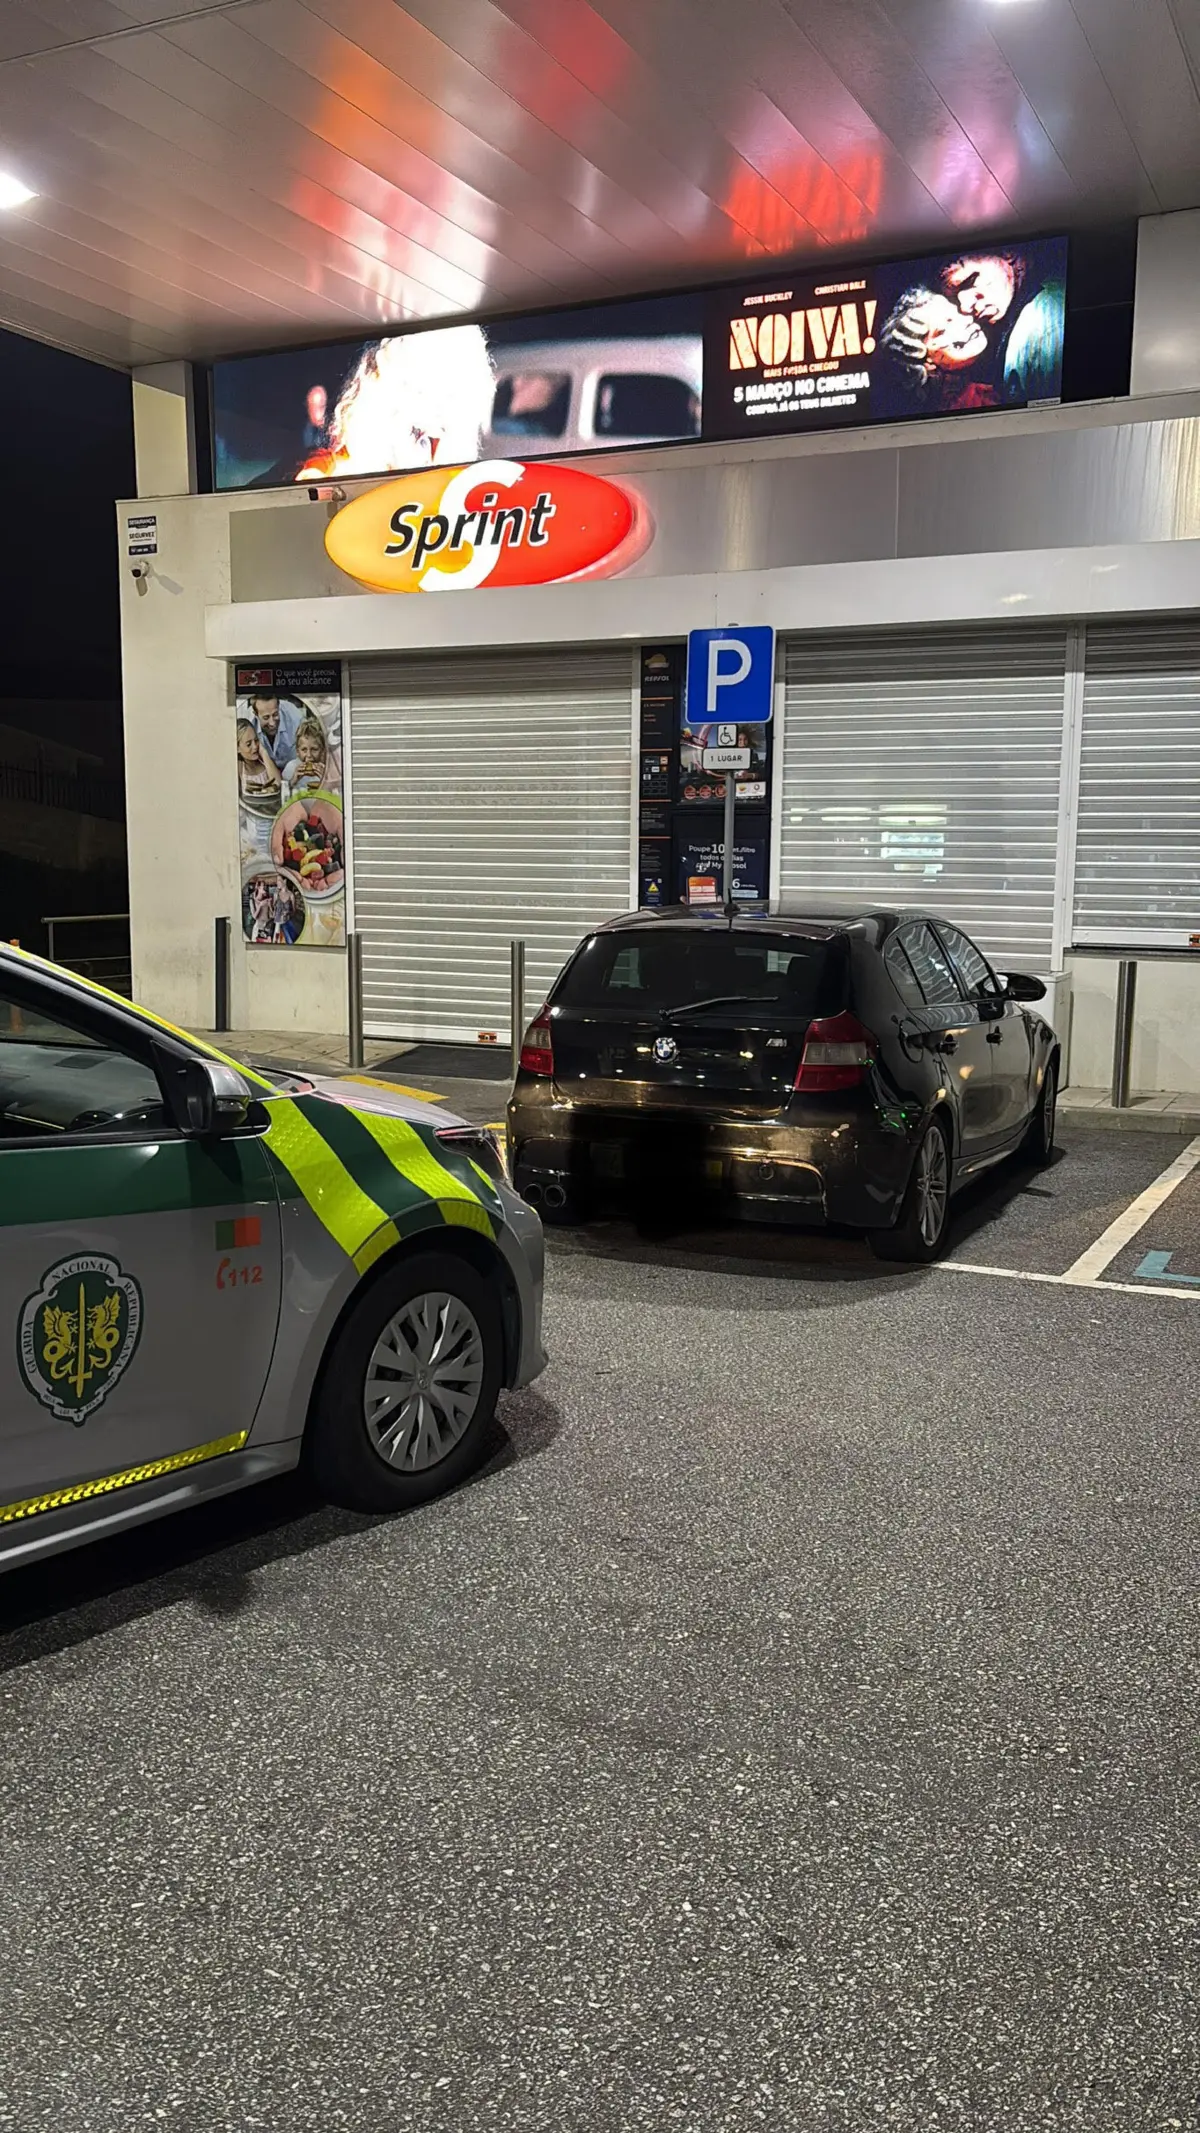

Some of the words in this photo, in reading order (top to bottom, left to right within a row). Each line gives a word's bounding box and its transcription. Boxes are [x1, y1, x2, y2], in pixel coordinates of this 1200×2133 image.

[729, 300, 878, 370] NOIVA!
[734, 386, 744, 403] 5
[746, 381, 793, 402] MARÇO
[795, 378, 815, 396] NO
[816, 372, 870, 393] CINEMA
[384, 493, 555, 570] Sprint
[707, 639, 752, 712] P
[52, 1260, 112, 1282] NACIONAL
[229, 1266, 263, 1286] 112
[23, 1321, 36, 1374] GUARDA
[115, 1282, 138, 1373] REPUBLICANA
